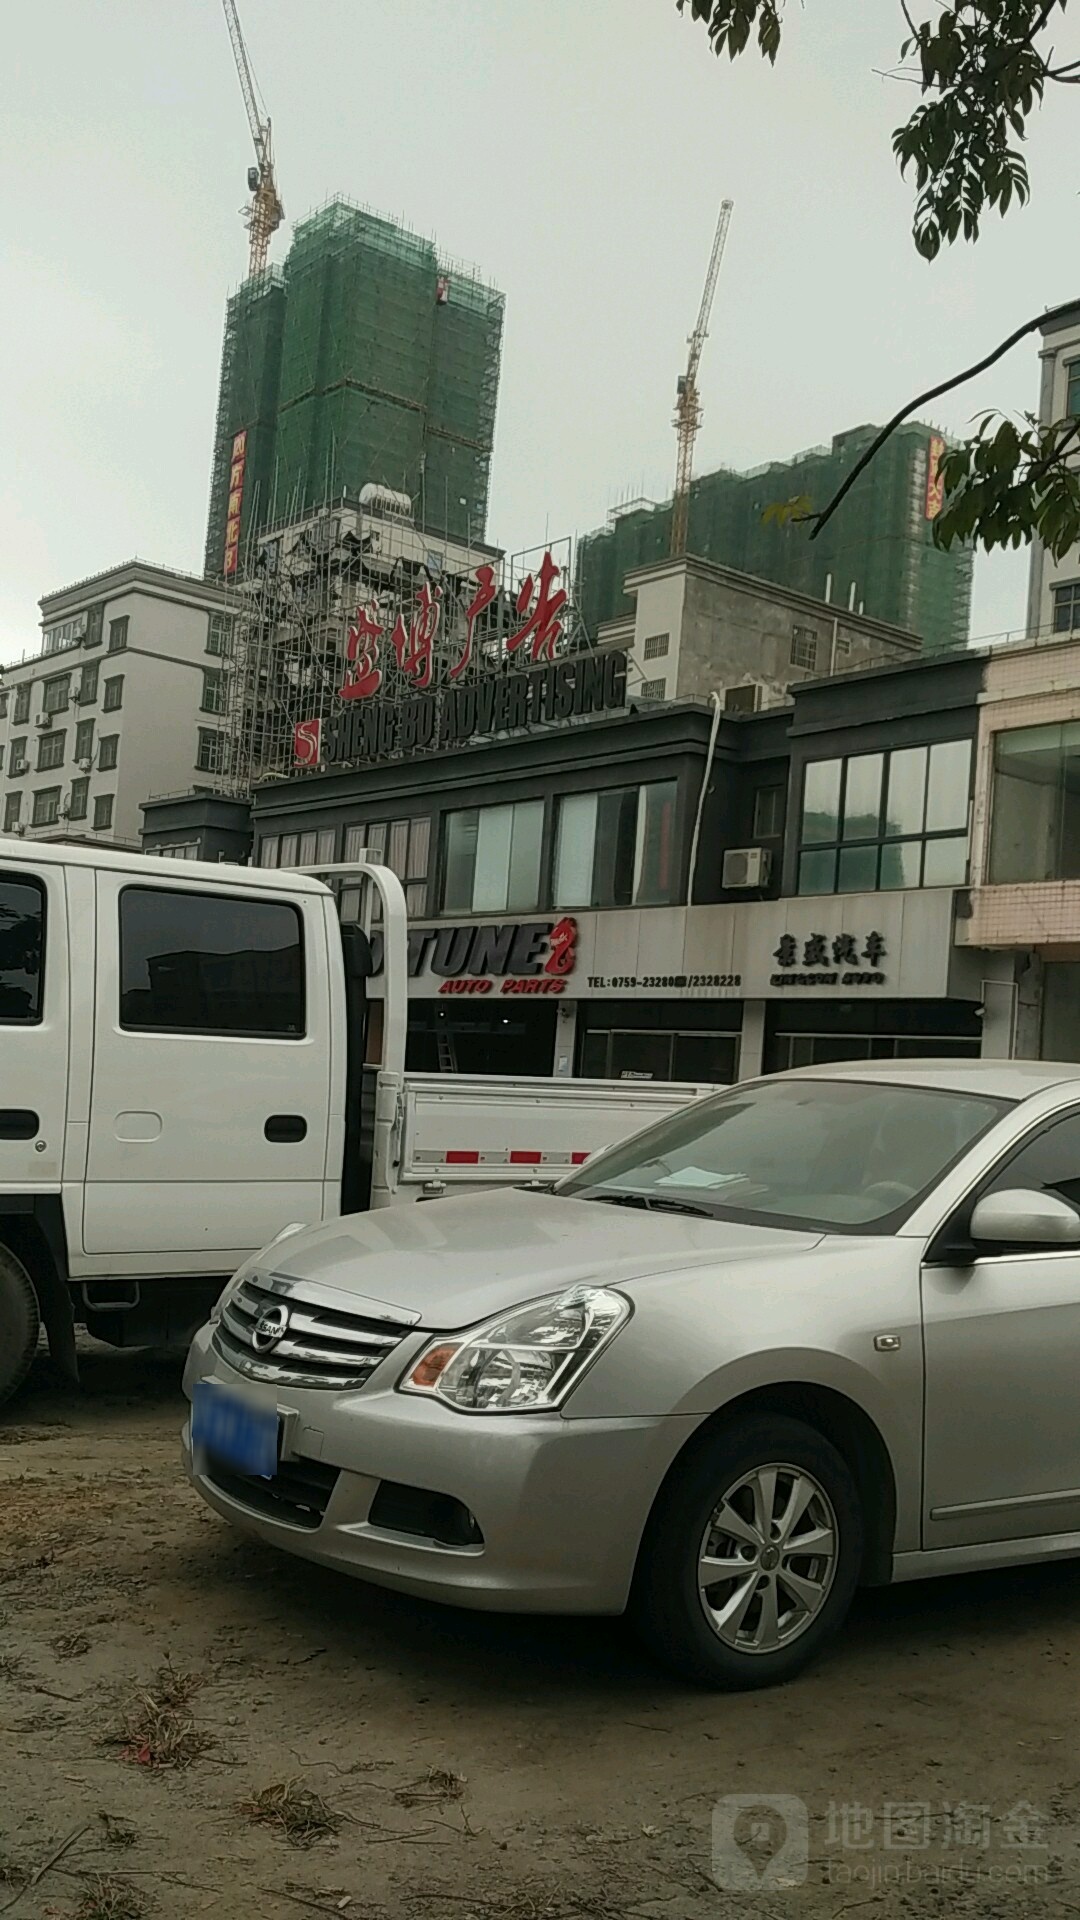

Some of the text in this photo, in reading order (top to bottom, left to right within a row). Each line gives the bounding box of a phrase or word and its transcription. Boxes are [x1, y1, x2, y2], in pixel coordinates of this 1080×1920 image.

[339, 551, 568, 701] 盛博广告
[323, 704, 395, 763] SHENG
[400, 696, 436, 749] BO
[440, 650, 628, 741] ADVERTISING
[437, 977, 568, 995] AUTO PARTS
